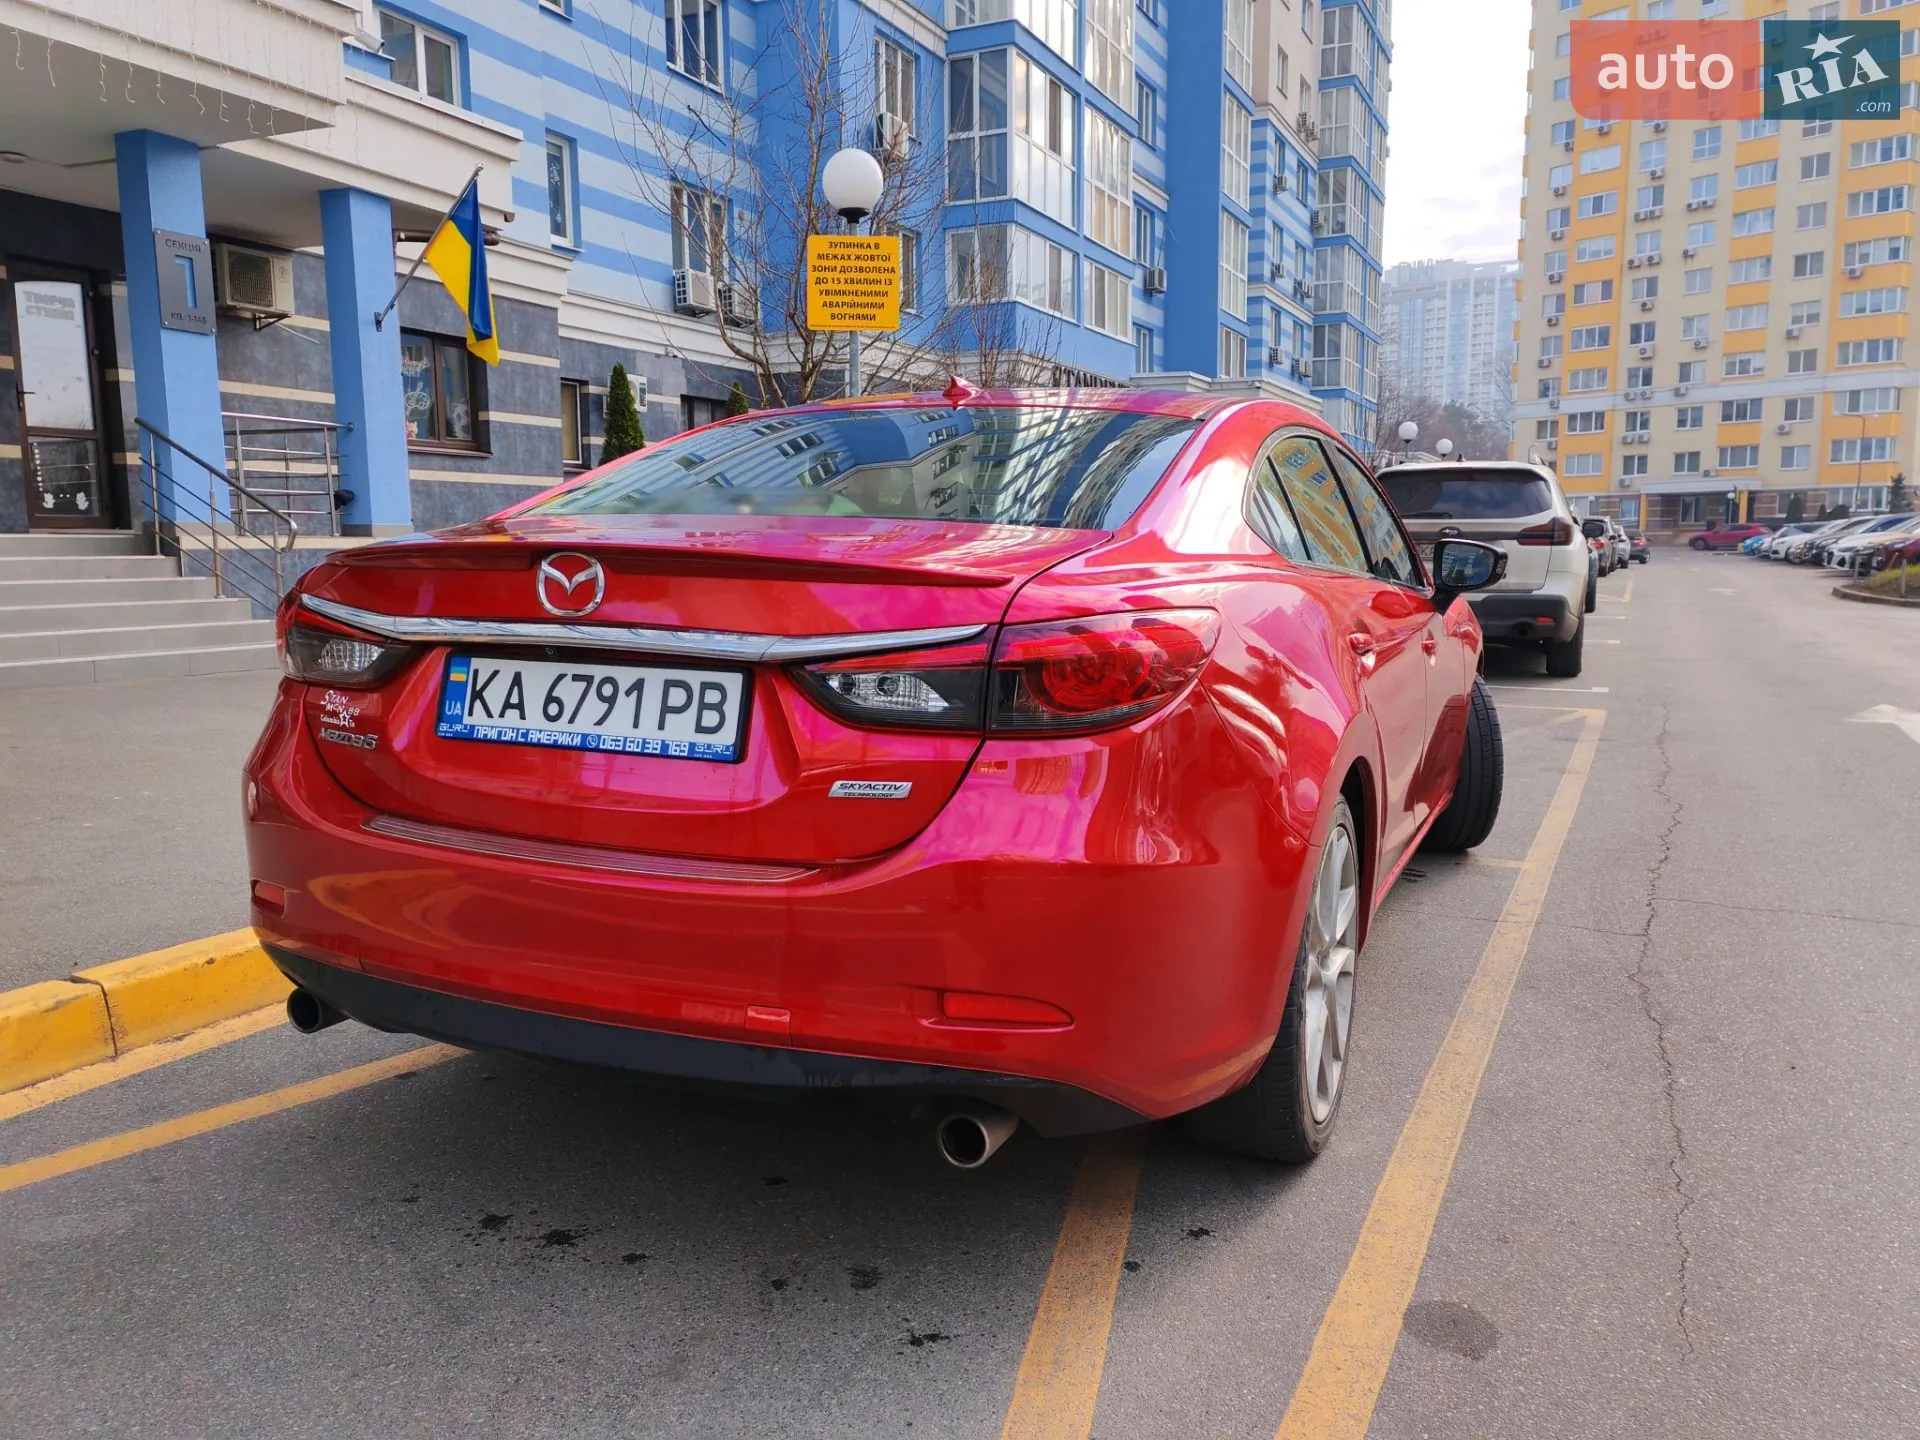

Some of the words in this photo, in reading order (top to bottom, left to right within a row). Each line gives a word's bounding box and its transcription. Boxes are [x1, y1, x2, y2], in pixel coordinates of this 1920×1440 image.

[165, 238, 201, 254] СЕКЦІЯ
[828, 241, 872, 250] ЗУПИНКА
[874, 242, 880, 250] В
[816, 253, 853, 261] МЕЖАХ
[854, 252, 891, 262] ЖОВТОЇ
[811, 264, 837, 273] ЗОНИ
[839, 265, 896, 274] ДОЗВОЛЕНА
[174, 254, 198, 309] 1
[814, 276, 829, 285] ДО
[831, 277, 841, 285] 15
[843, 277, 882, 286] ХВИЛИН
[884, 278, 893, 286] ІЗ
[818, 288, 889, 298] УВІМКНЕНИМИ
[822, 299, 885, 309] АВАРІЙНИМИ
[830, 312, 876, 321] ВОГНЯМИ
[467, 668, 527, 721] KA
[542, 673, 645, 729] 6791
[657, 679, 728, 735] PB
[445, 700, 462, 716] UA
[473, 725, 517, 742] ПРИГОН
[527, 731, 582, 747] АМЕРИКИ
[599, 734, 623, 751] 063
[625, 736, 643, 752] 60
[644, 738, 661, 754] 39
[664, 740, 689, 757] 769
[839, 782, 903, 791] SKYACTIV
